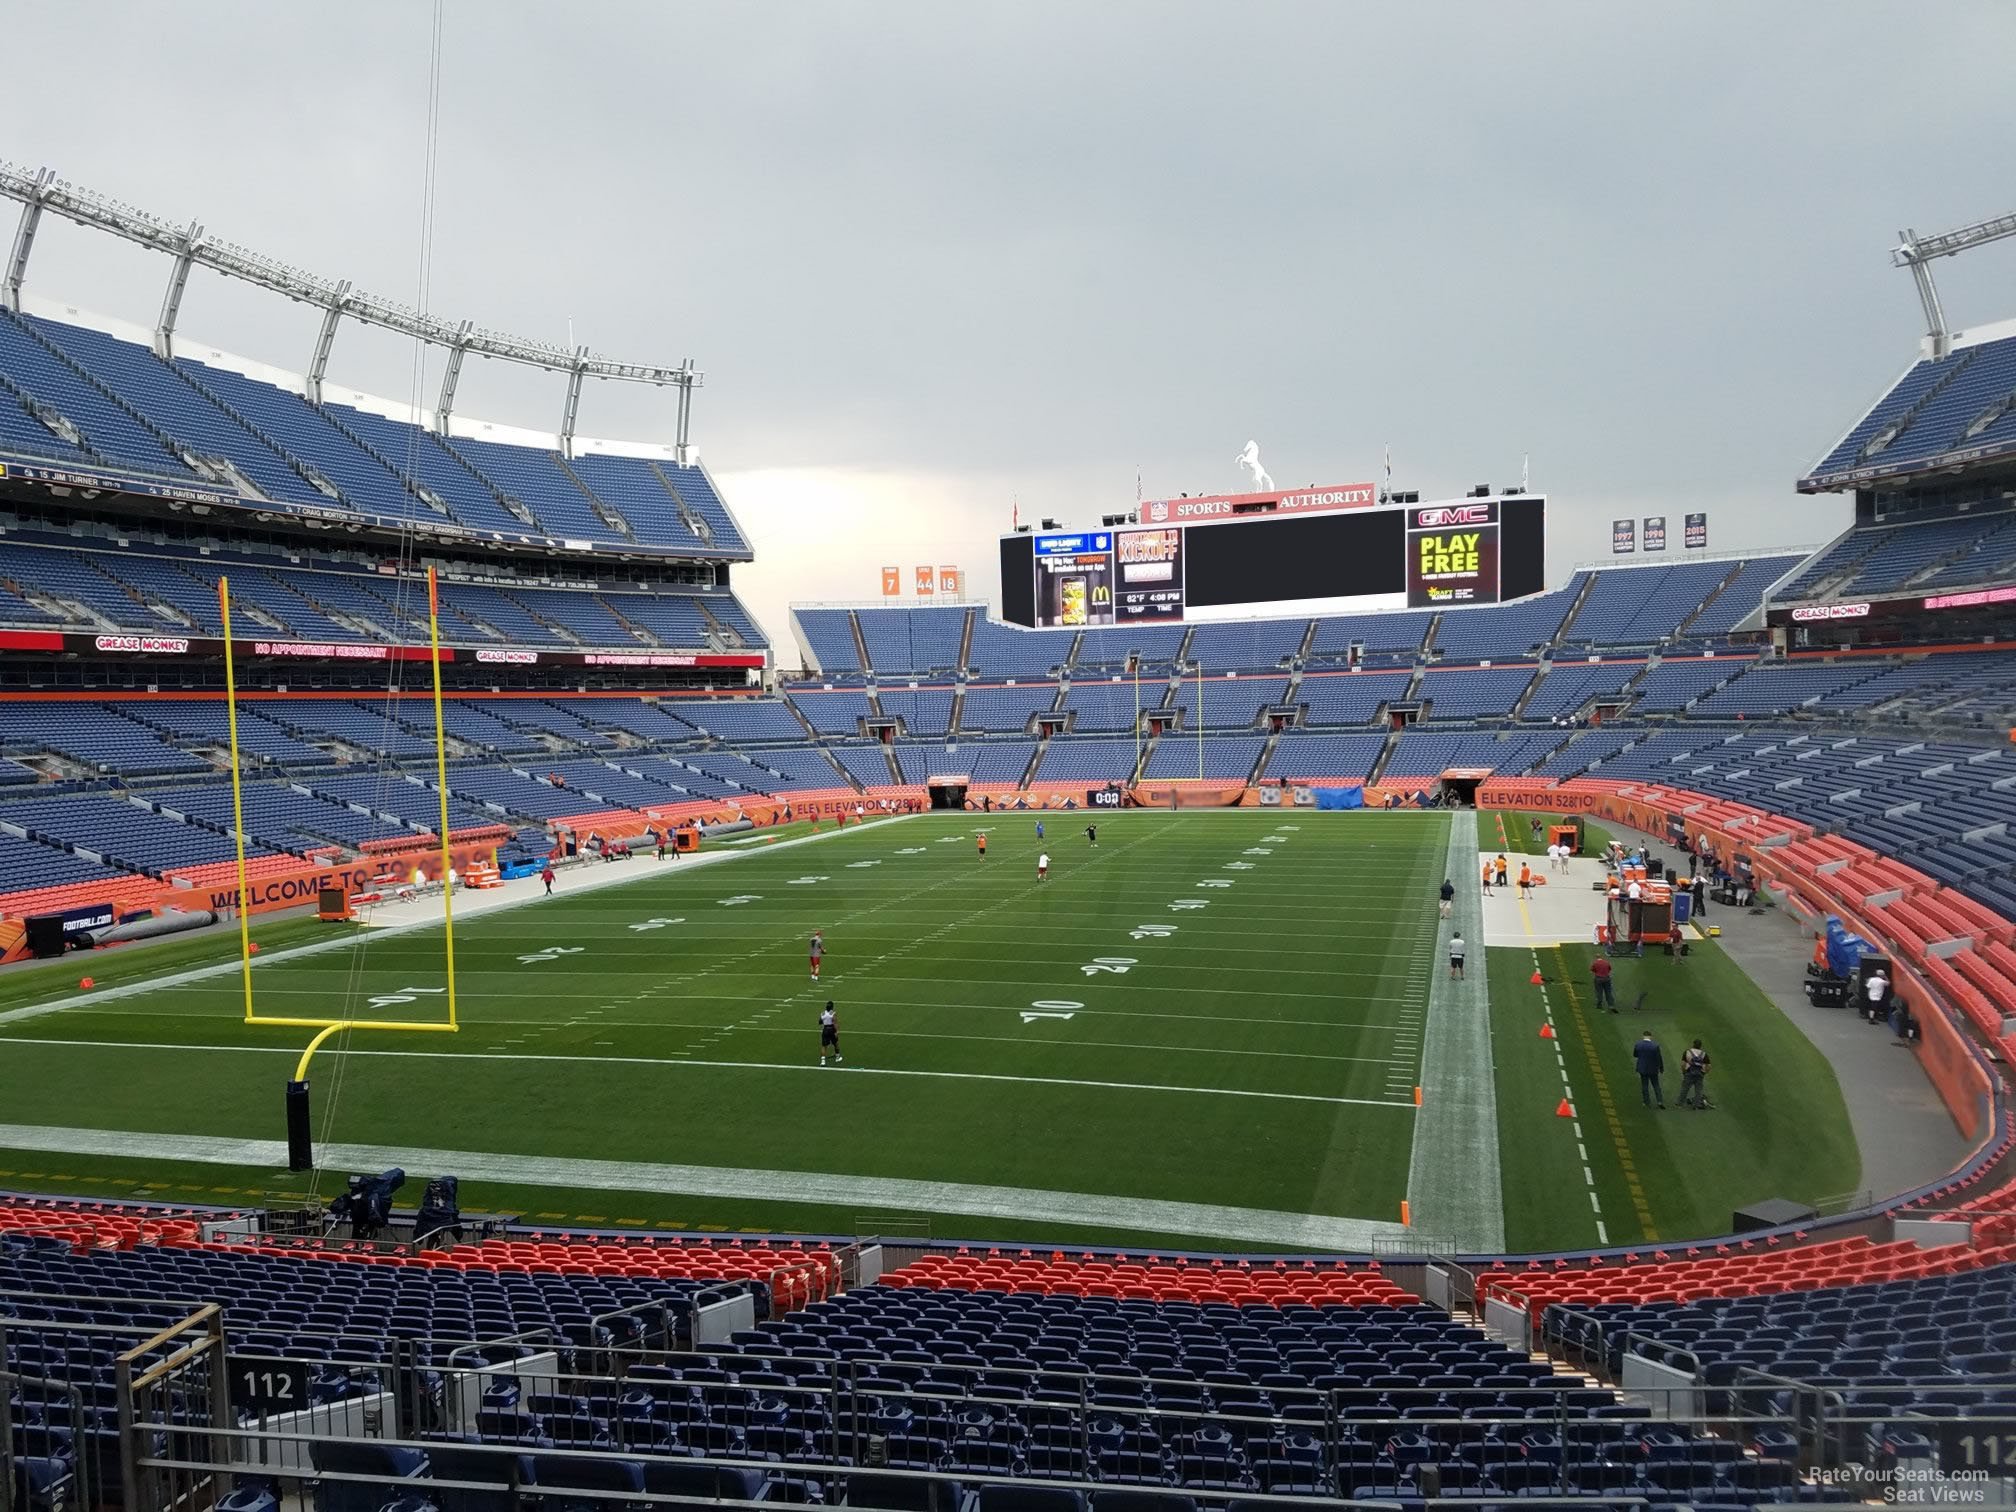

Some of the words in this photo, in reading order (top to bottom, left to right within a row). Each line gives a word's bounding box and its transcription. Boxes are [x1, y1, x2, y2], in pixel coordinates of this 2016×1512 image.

[39, 470, 48, 479] 15
[52, 472, 66, 482] JIM
[67, 474, 98, 486] TURNER
[1831, 473, 1849, 483] JOHN
[1852, 470, 1875, 480] LYNCH
[162, 487, 171, 496] 25
[173, 489, 196, 500] HAVEN
[197, 493, 220, 503] MOSES
[1177, 501, 1231, 516] SPORTS
[1279, 489, 1372, 509] AUTHORITY
[302, 507, 321, 517] CRAIG
[323, 510, 348, 520] MORTON
[1418, 504, 1489, 527] GMC
[1421, 533, 1480, 554] PLAY
[1118, 542, 1178, 563] KICKOFF
[1421, 552, 1479, 573] FREE
[887, 579, 895, 591] 7
[917, 579, 934, 591] 44
[942, 577, 955, 590] 18
[1792, 606, 1829, 621] GREASE
[1830, 603, 1870, 618] MONKEY
[96, 636, 139, 651] GREASE
[141, 637, 188, 652] MONKEY
[255, 642, 270, 654] NO
[272, 643, 335, 657] APPOINTMENT
[336, 645, 387, 658] NECESSARY
[476, 651, 505, 662] GREASE
[506, 652, 538, 663] MONKEY
[1481, 792, 1553, 807] ELEVATION
[211, 874, 331, 907] WELCOME
[63, 913, 112, 932] FOOTBALL.COM
[1080, 957, 1139, 974] 20
[1019, 1000, 1085, 1030] 10
[243, 1371, 294, 1400] 112
